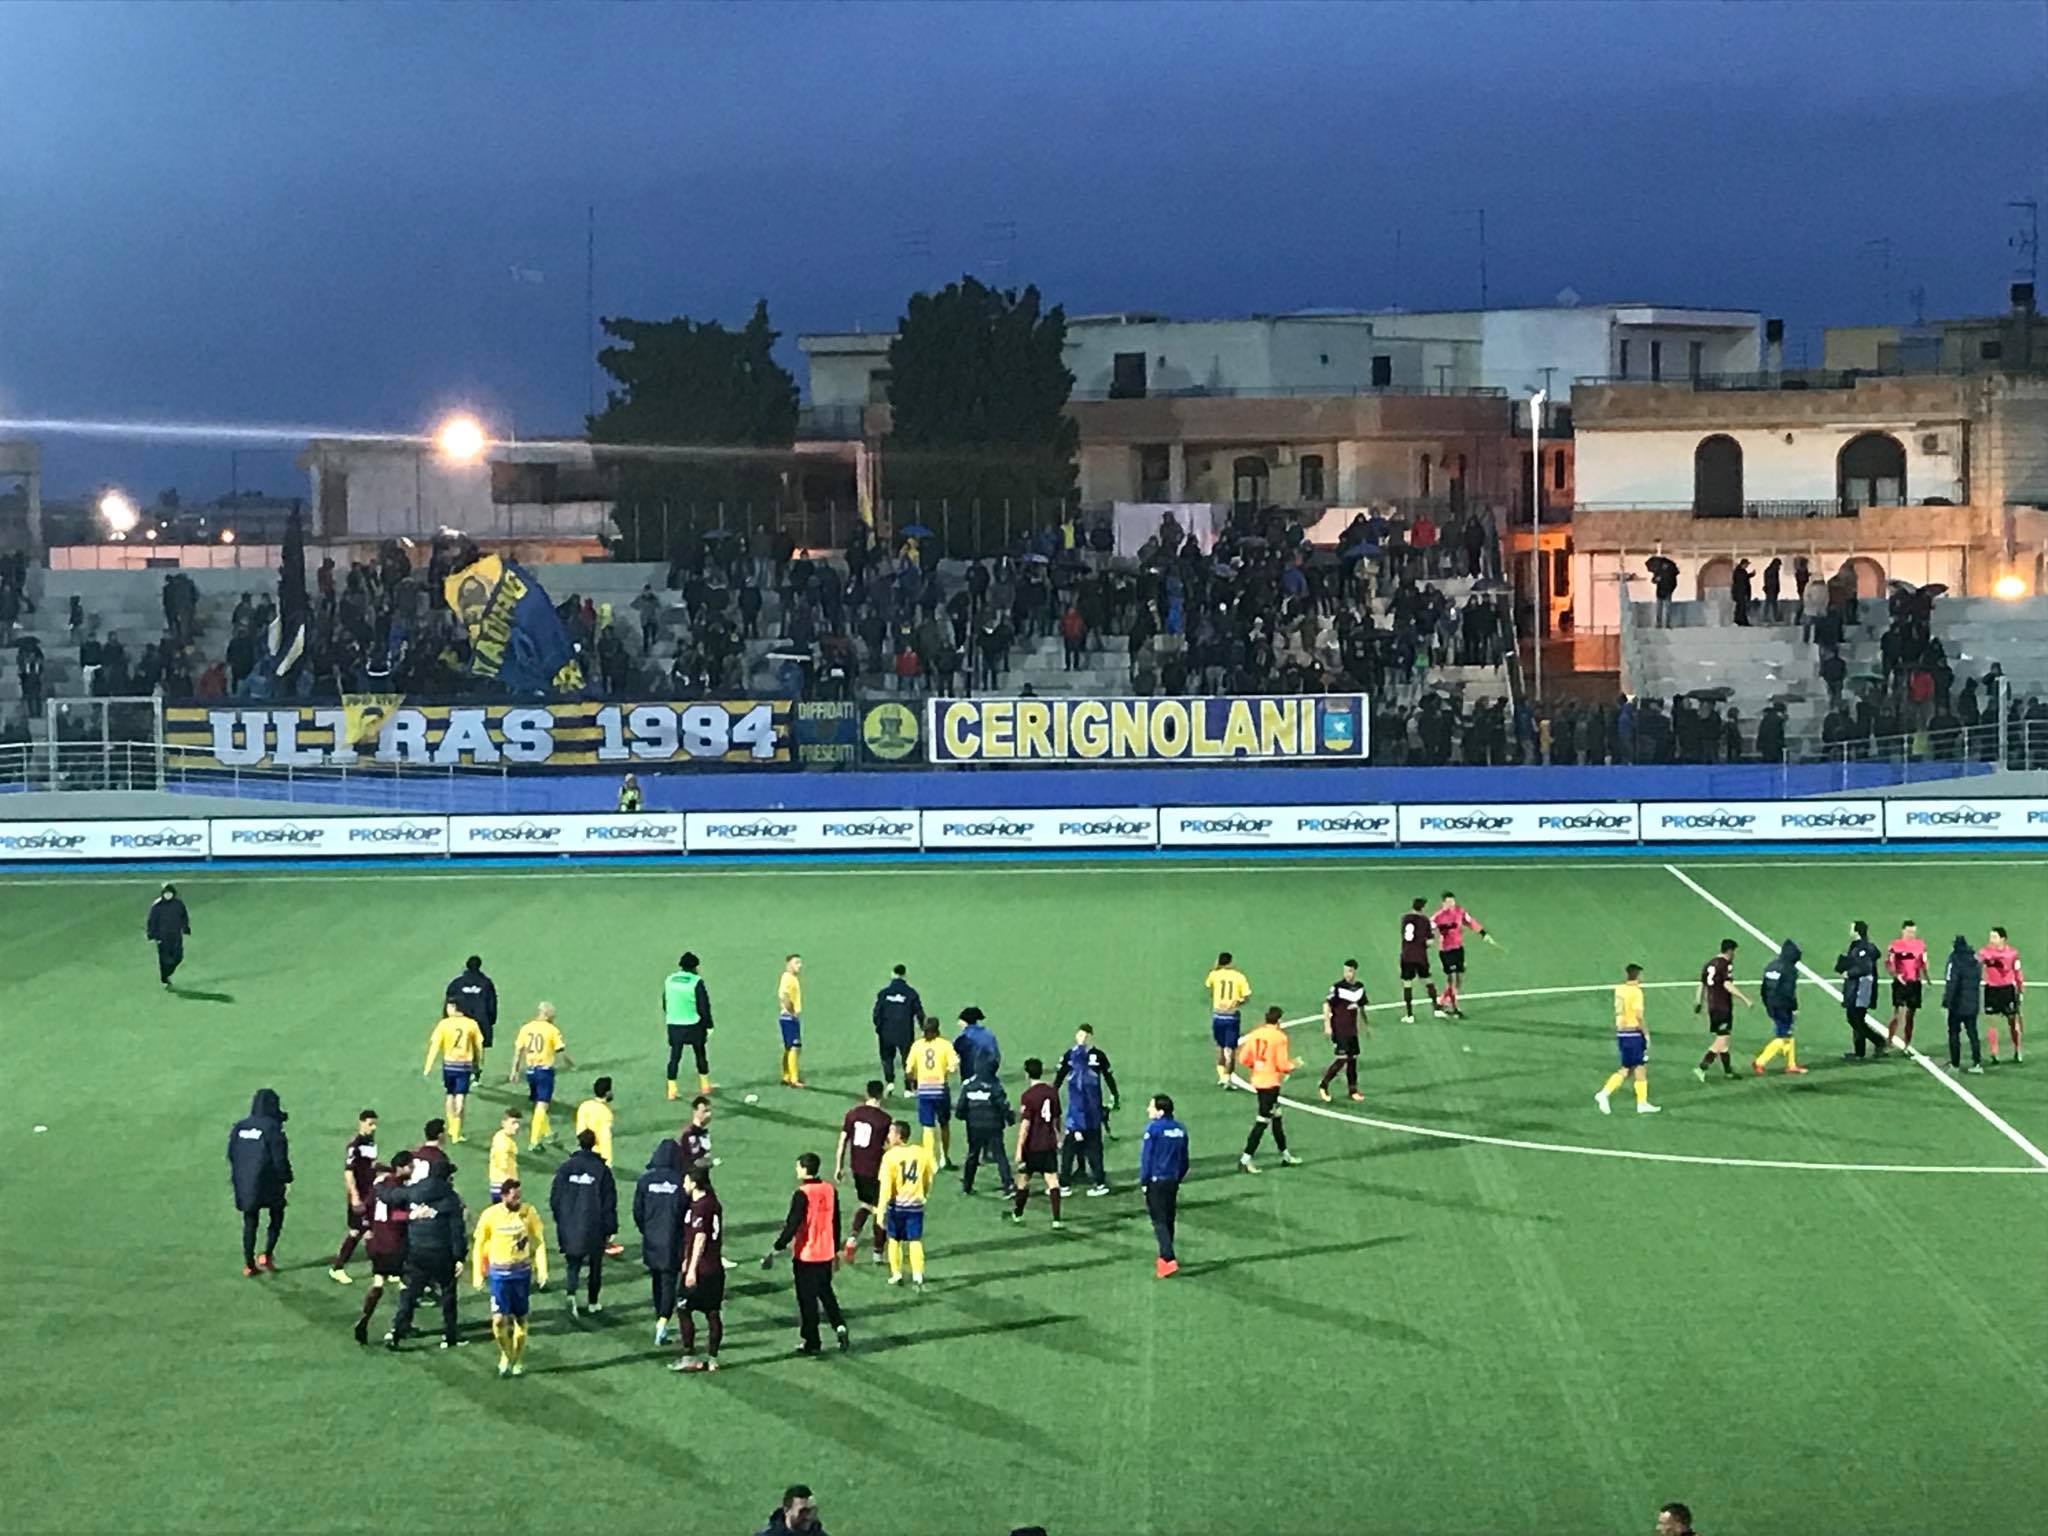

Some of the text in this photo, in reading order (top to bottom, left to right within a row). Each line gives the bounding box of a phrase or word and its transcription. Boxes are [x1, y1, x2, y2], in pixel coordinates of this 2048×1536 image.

[798, 701, 853, 720] DIFFIDATI
[209, 704, 777, 764] ULTRAS 1984
[943, 698, 1316, 757] CERIGNOLANI
[1298, 818, 1390, 832] PROSHOP
[1420, 817, 1513, 830] PROSHOP
[1539, 816, 1632, 829] PROSHOP
[1662, 815, 1756, 828] PROSHOP
[1782, 813, 1876, 827] PROSHOP
[1907, 812, 2001, 825] PROSHOP
[586, 827, 677, 840] PROSHOP
[707, 825, 797, 838] PROSHOP
[823, 823, 914, 837] PROSHOP
[943, 822, 1034, 836] PROSHOP
[1059, 821, 1151, 834] PROSHOP
[1180, 820, 1272, 833] PROSHOP
[111, 834, 202, 847] PROSHOP
[232, 830, 325, 843] PROSHOP
[349, 828, 441, 841] PROSHOP
[470, 828, 562, 841] PROSHOP
[1404, 922, 1415, 942] 8
[1220, 980, 1234, 1001] 11
[454, 1028, 463, 1049] 2
[527, 1032, 544, 1054] 20
[925, 1048, 935, 1070] 8
[1040, 1098, 1051, 1123] 4
[899, 1159, 918, 1186] 14
